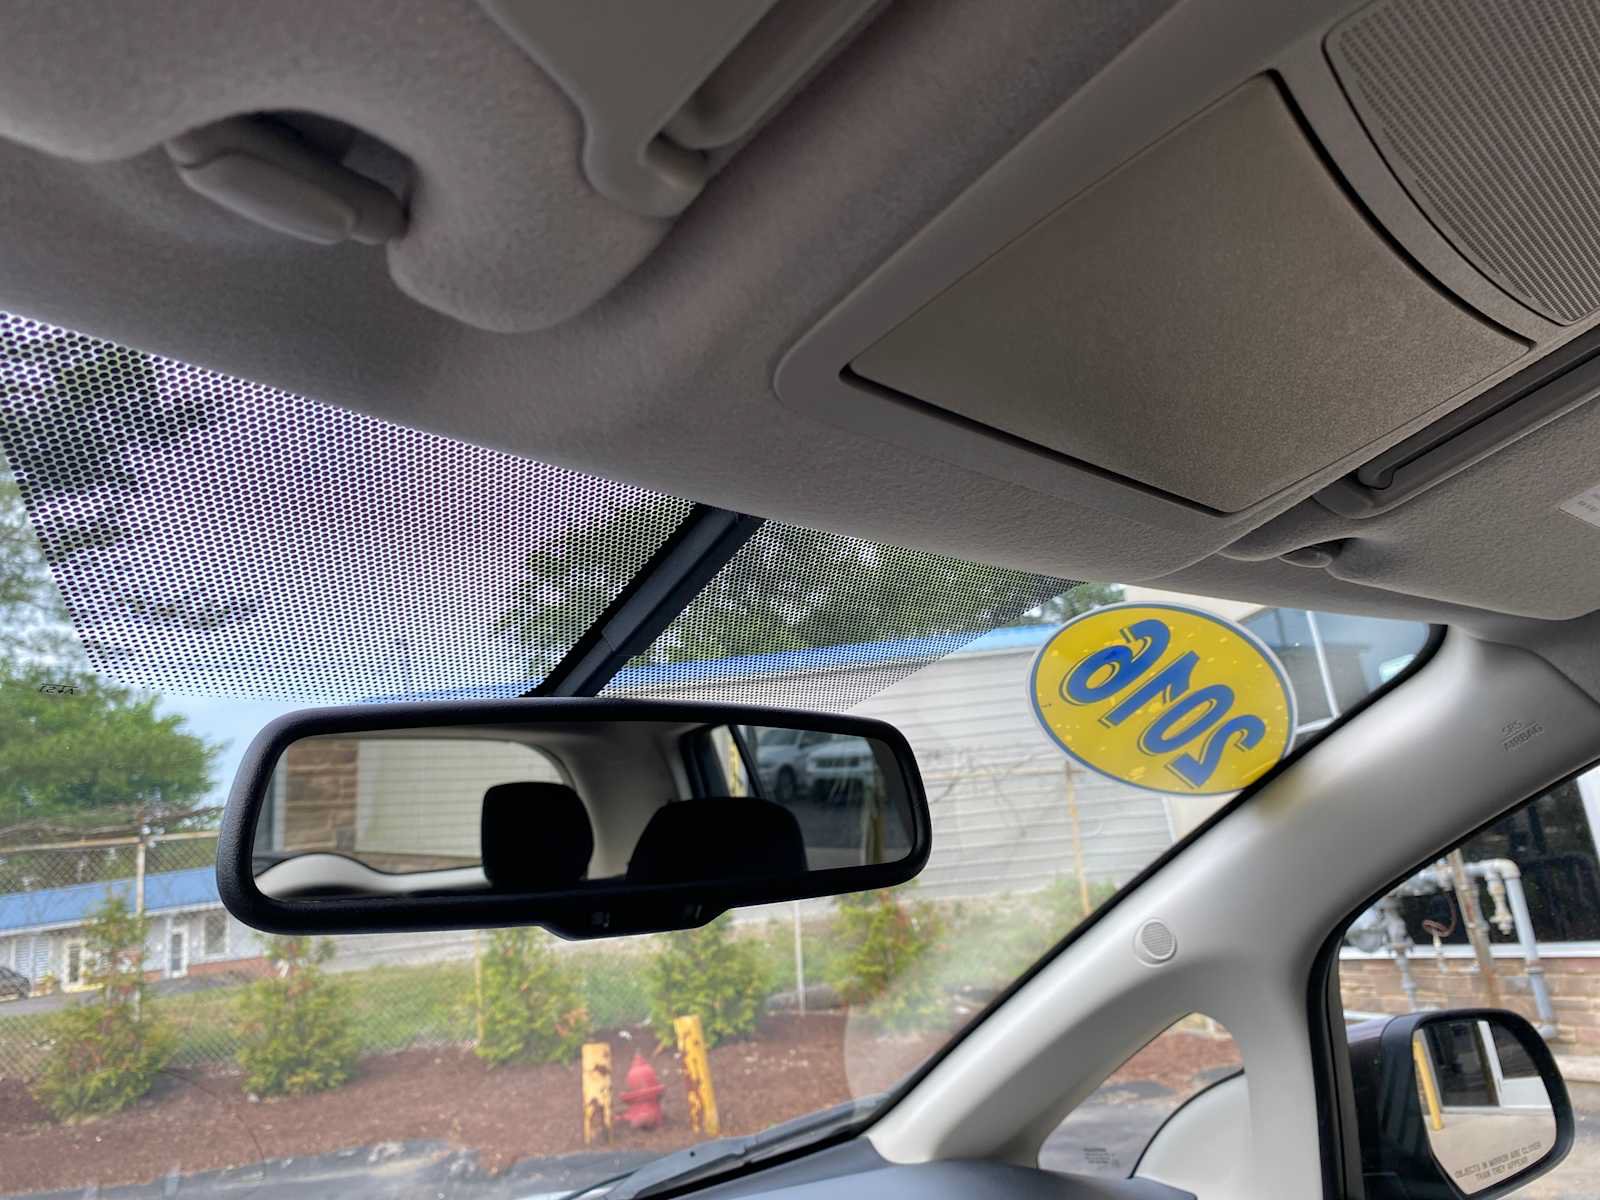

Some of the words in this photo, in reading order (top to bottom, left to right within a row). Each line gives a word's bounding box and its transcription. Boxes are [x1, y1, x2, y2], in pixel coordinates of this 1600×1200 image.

[1503, 723, 1544, 751] AIRBAG
[1455, 1162, 1481, 1179] OBJECTS
[1488, 1153, 1509, 1167] MIRROR
[1510, 1149, 1521, 1159] ARE
[1521, 1141, 1542, 1155] CLOSER
[1507, 1156, 1529, 1169] APPEAR
